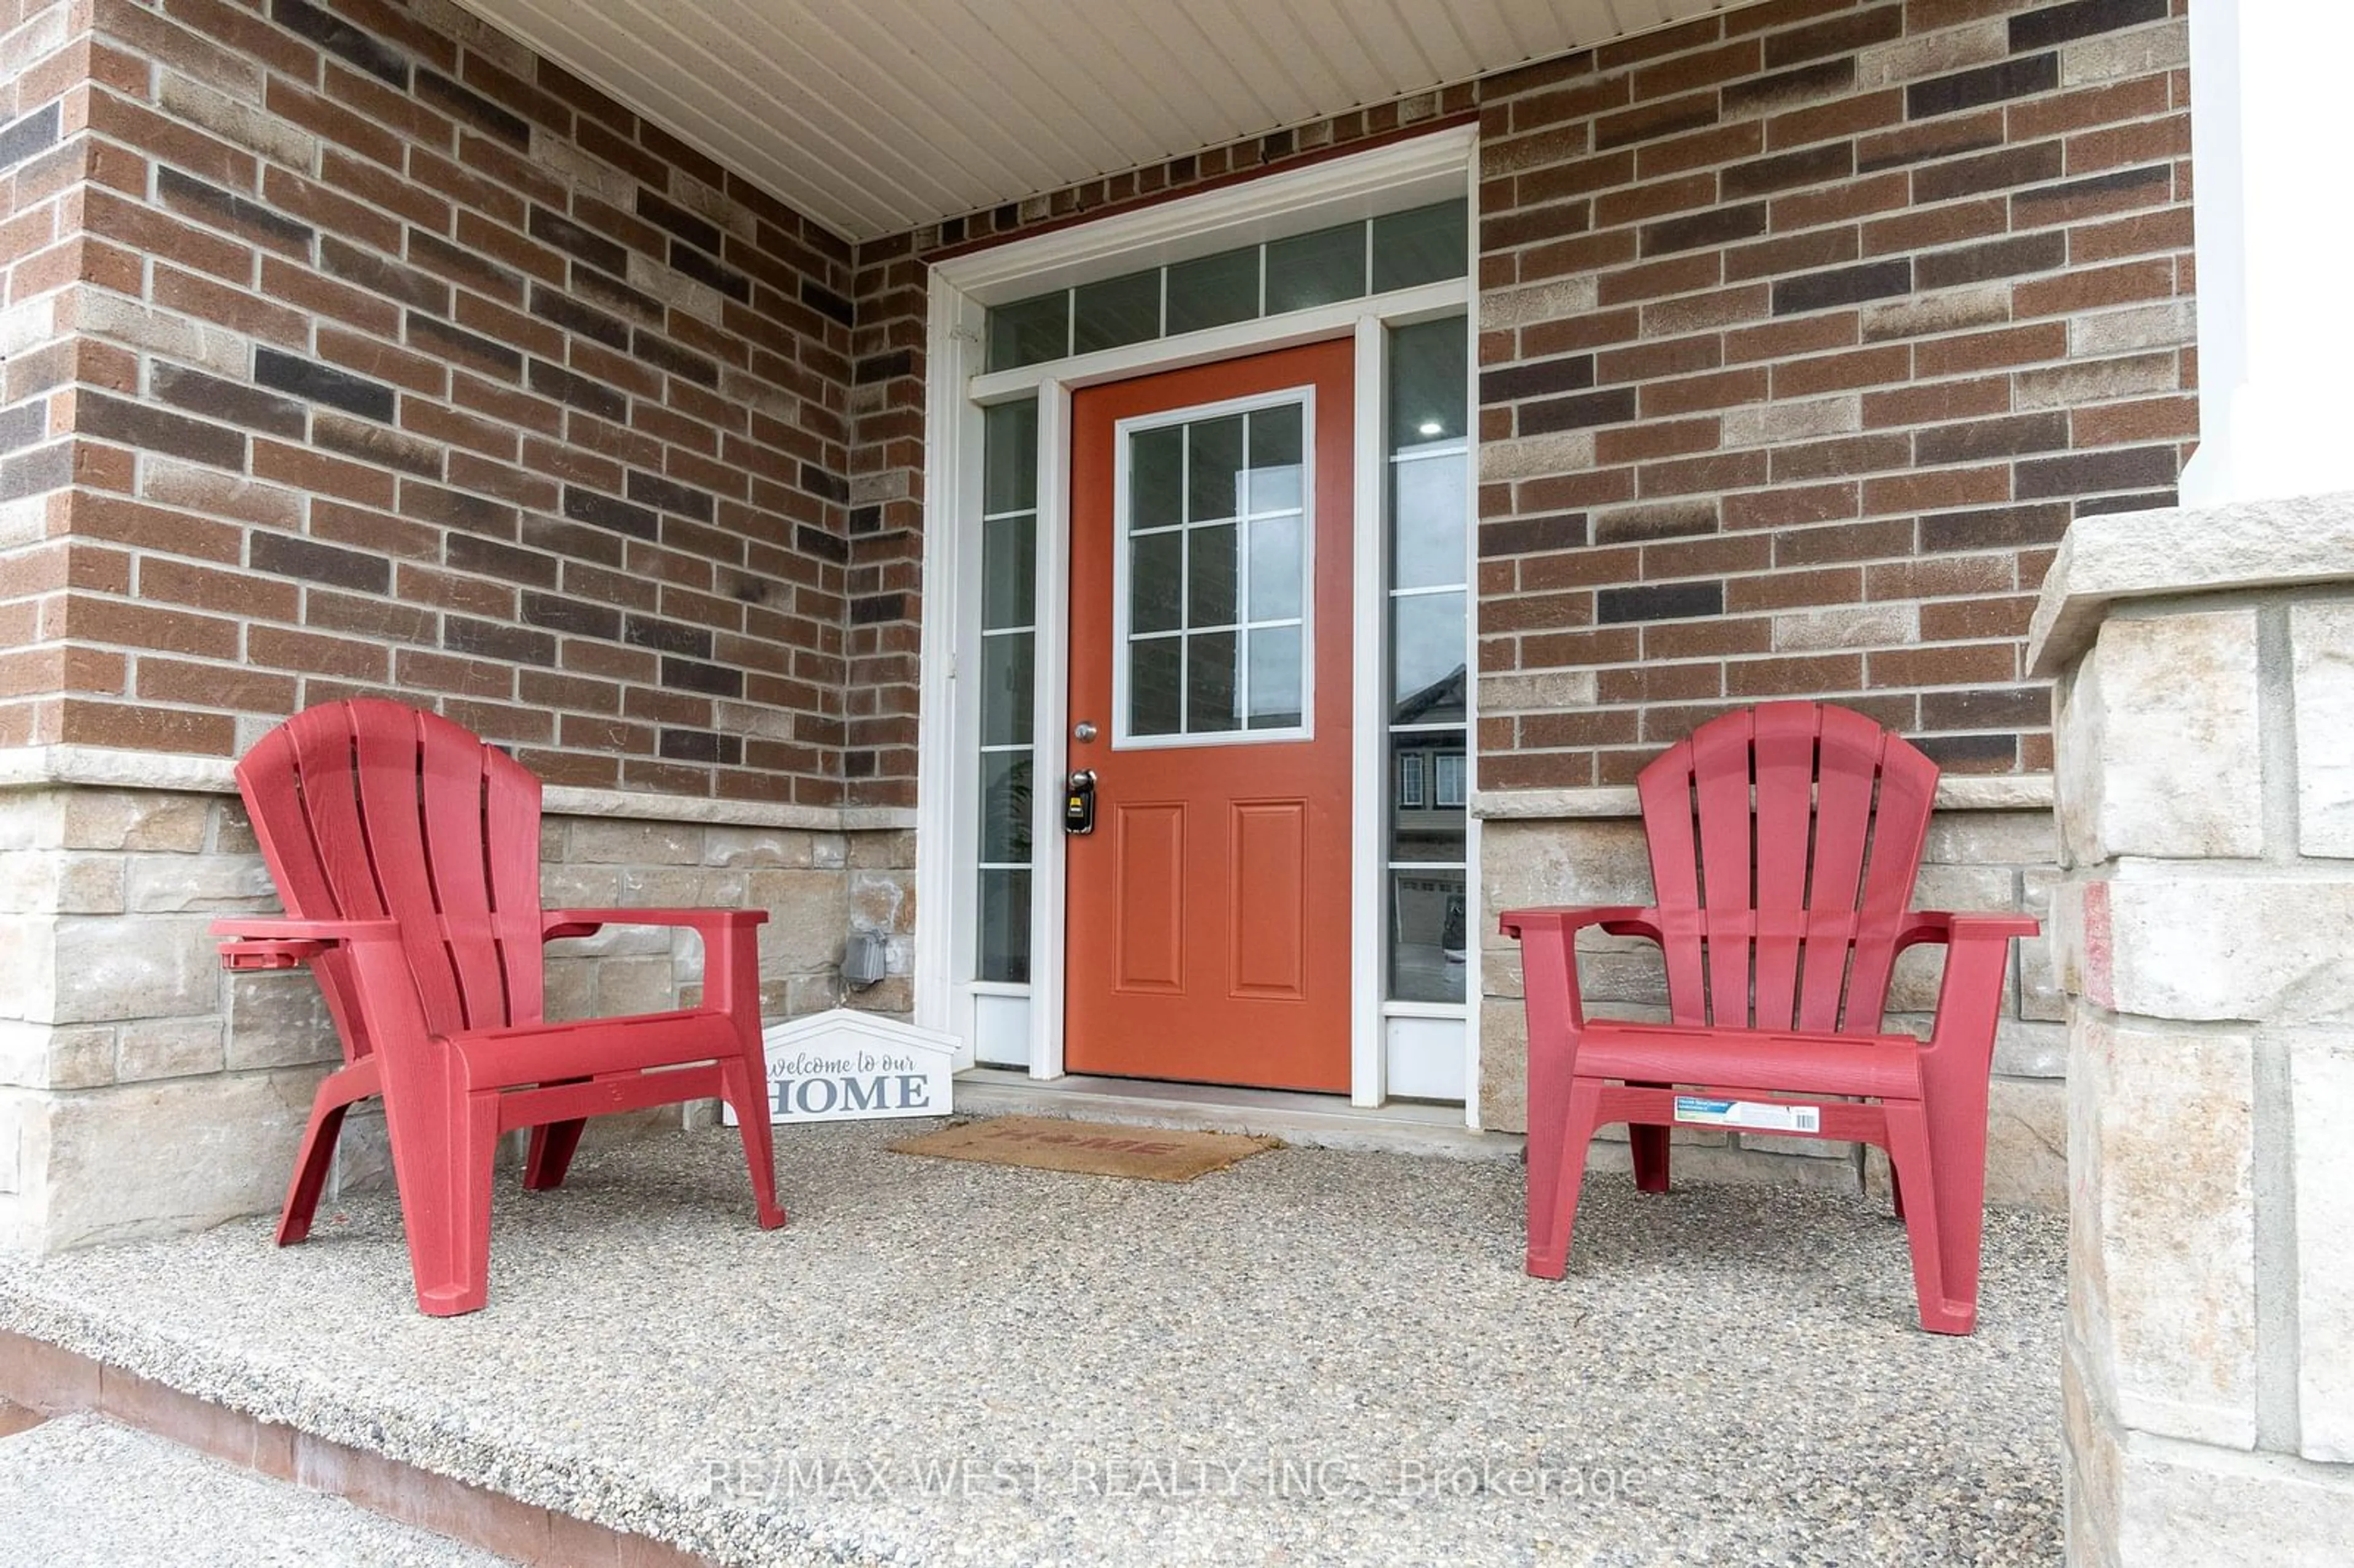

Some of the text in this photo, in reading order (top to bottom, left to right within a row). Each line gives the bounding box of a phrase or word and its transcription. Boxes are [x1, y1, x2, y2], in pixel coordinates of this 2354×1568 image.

[768, 1050, 918, 1077] welcome to our
